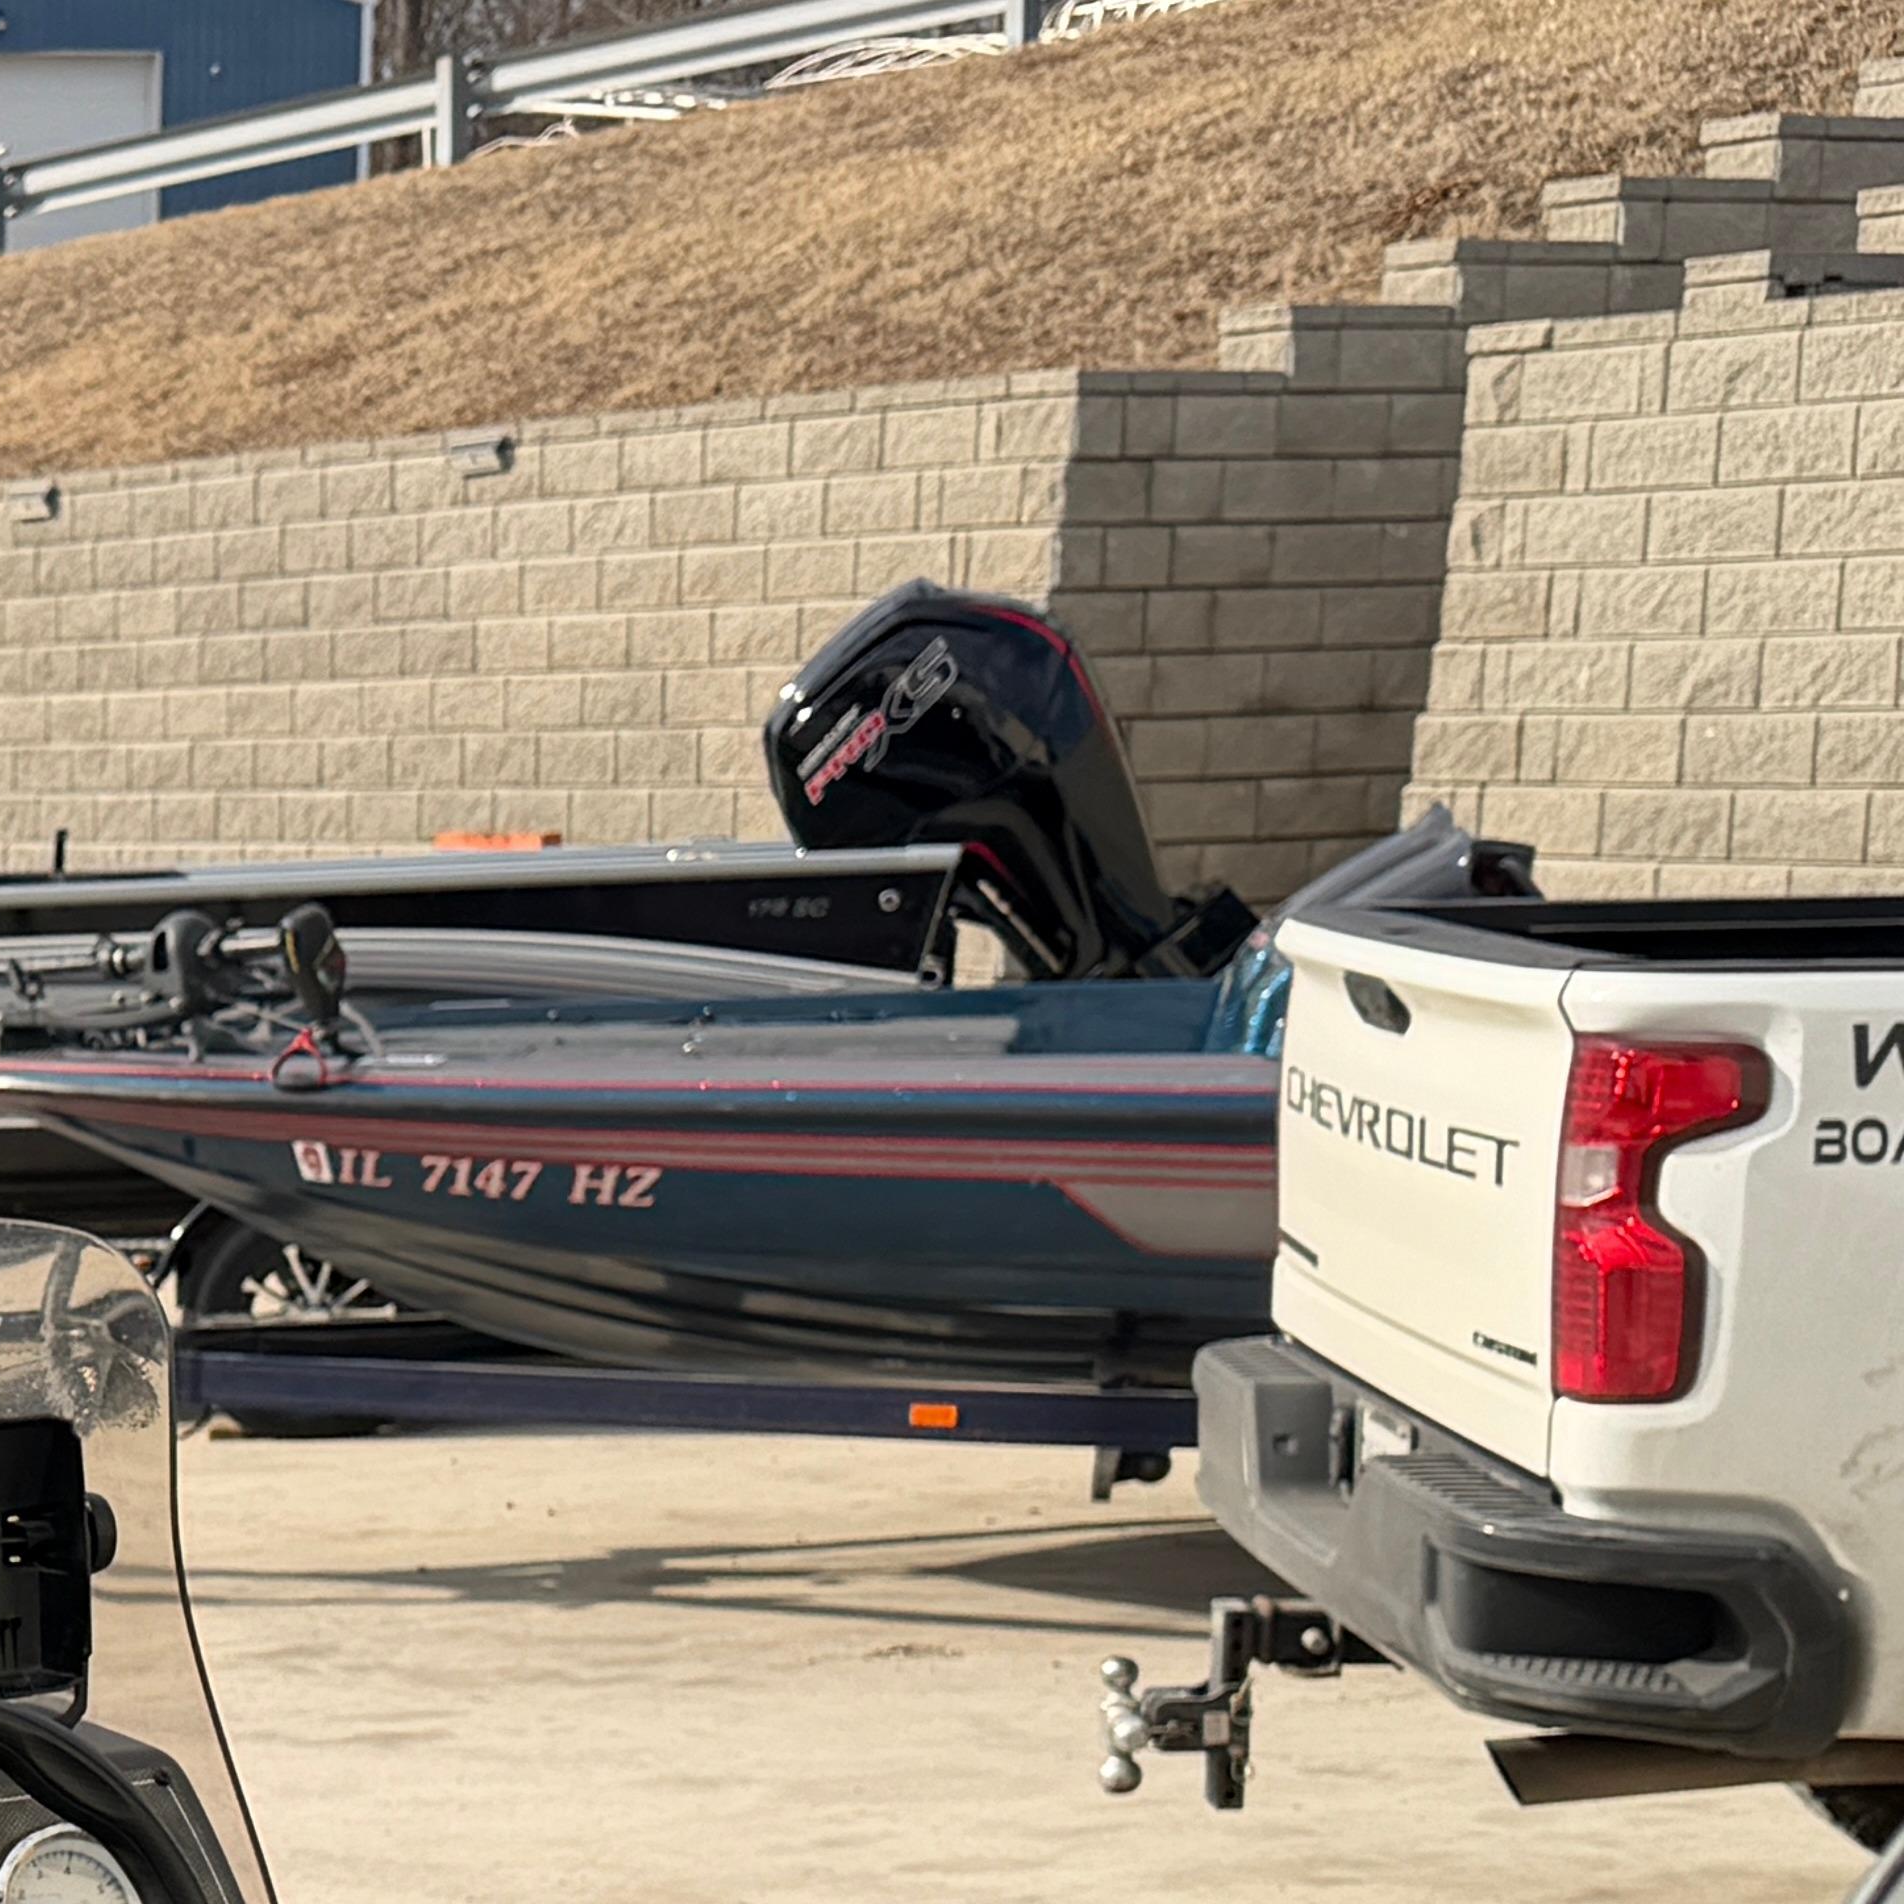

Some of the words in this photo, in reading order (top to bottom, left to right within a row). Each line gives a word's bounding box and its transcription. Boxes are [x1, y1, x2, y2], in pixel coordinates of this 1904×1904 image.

[1287, 1065, 1520, 1188] CHEVROLET
[338, 1148, 392, 1188] IL
[421, 1154, 543, 1201] 7147
[568, 1163, 663, 1208] HZ
